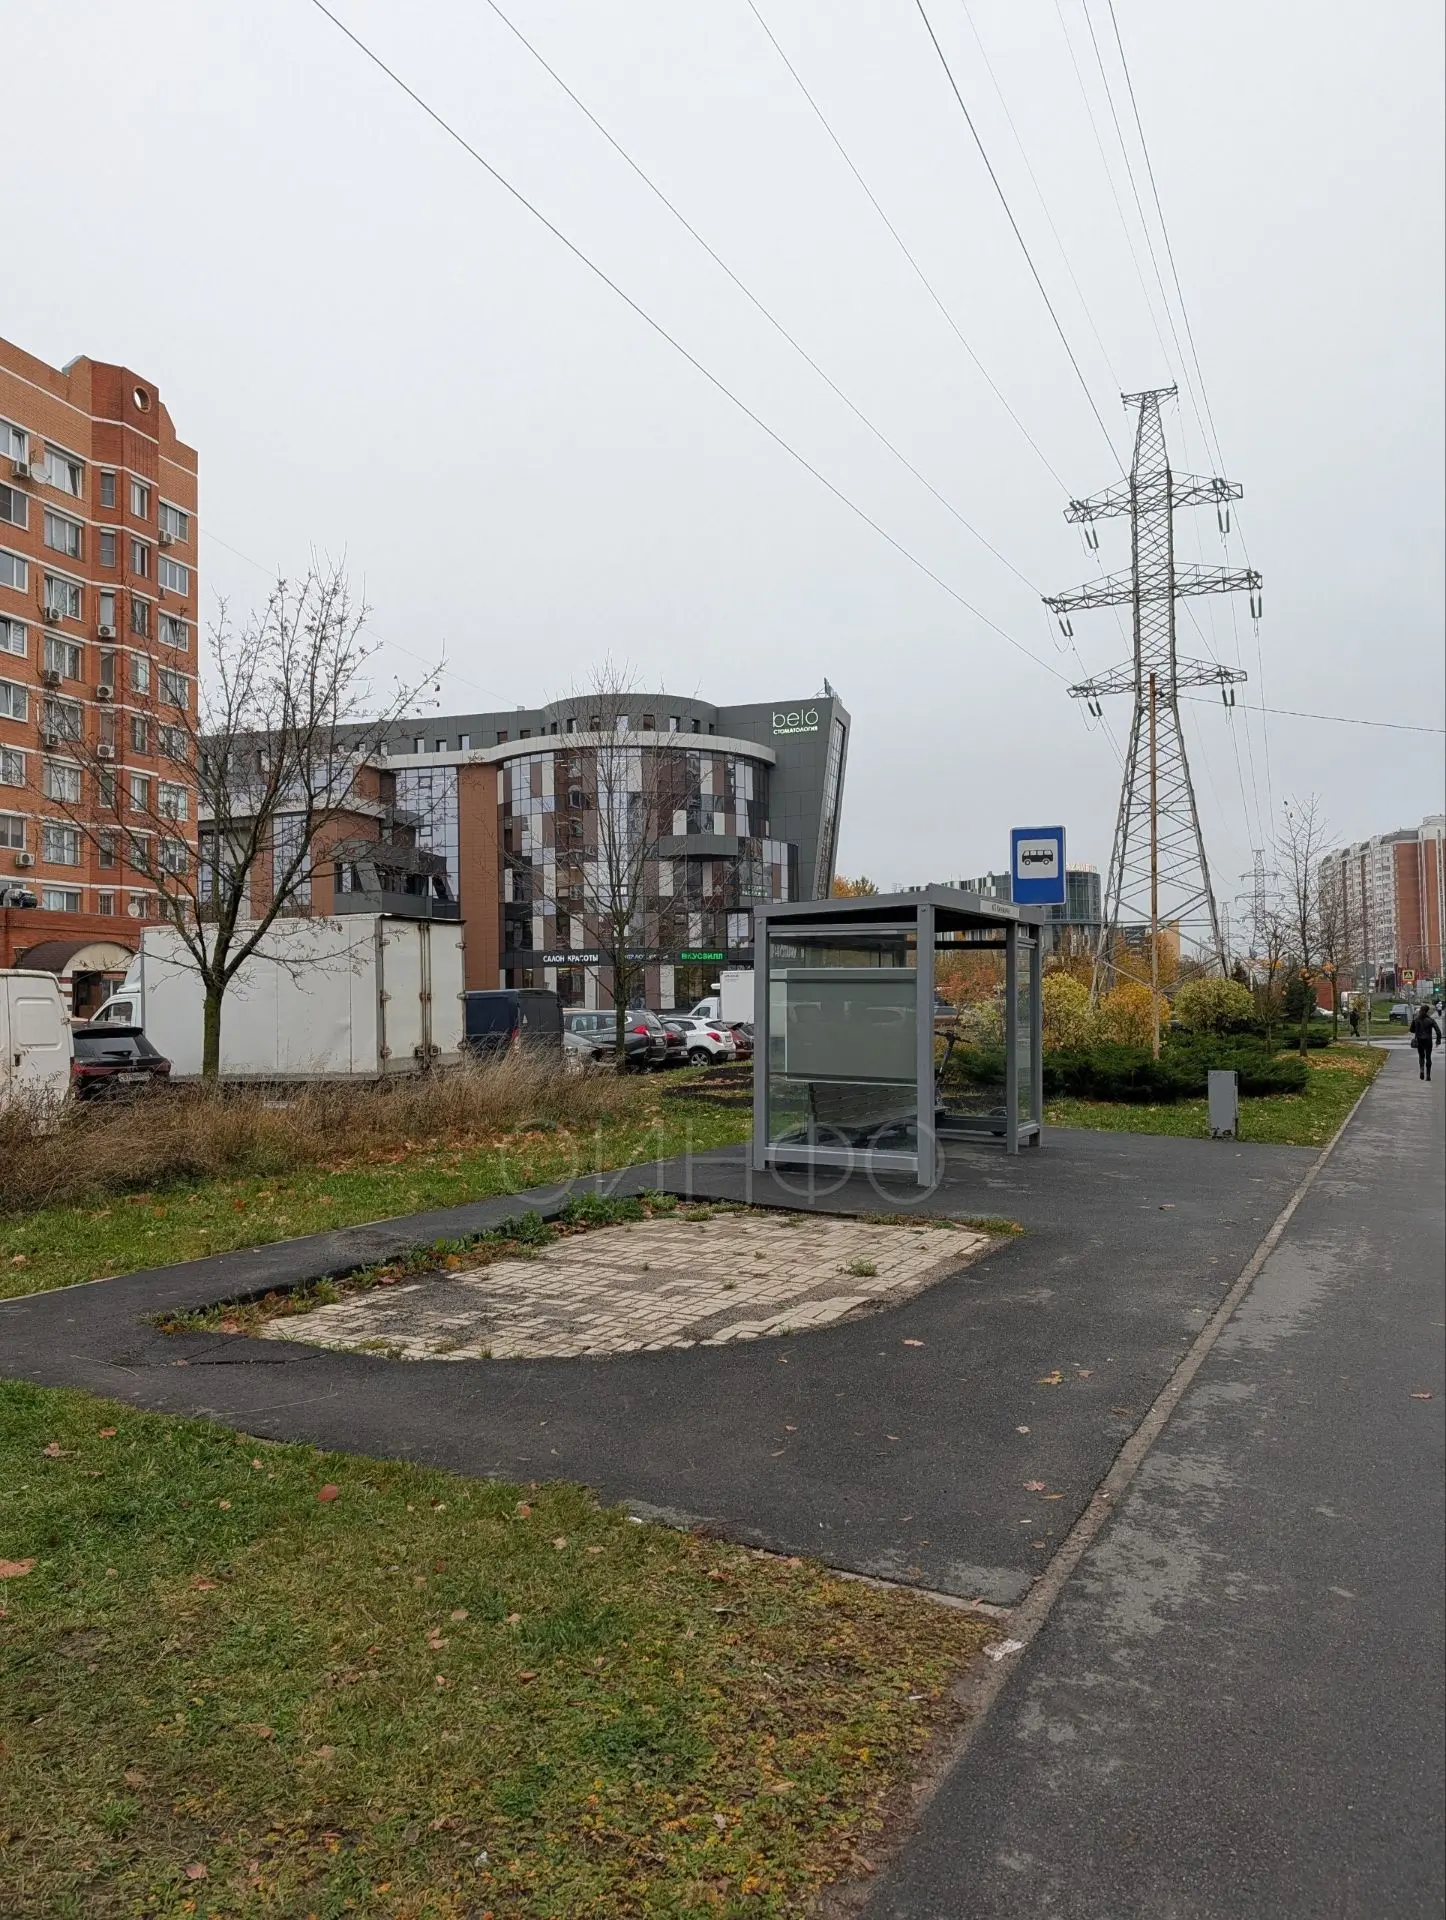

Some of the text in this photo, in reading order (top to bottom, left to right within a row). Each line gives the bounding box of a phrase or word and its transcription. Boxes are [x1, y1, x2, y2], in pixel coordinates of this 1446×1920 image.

[772, 708, 819, 728] beló
[773, 726, 818, 735] СТОМАТОЛОГИЯ
[567, 954, 599, 962] КРАСОТЫ
[681, 952, 723, 960] ВКУСВИЛЛ
